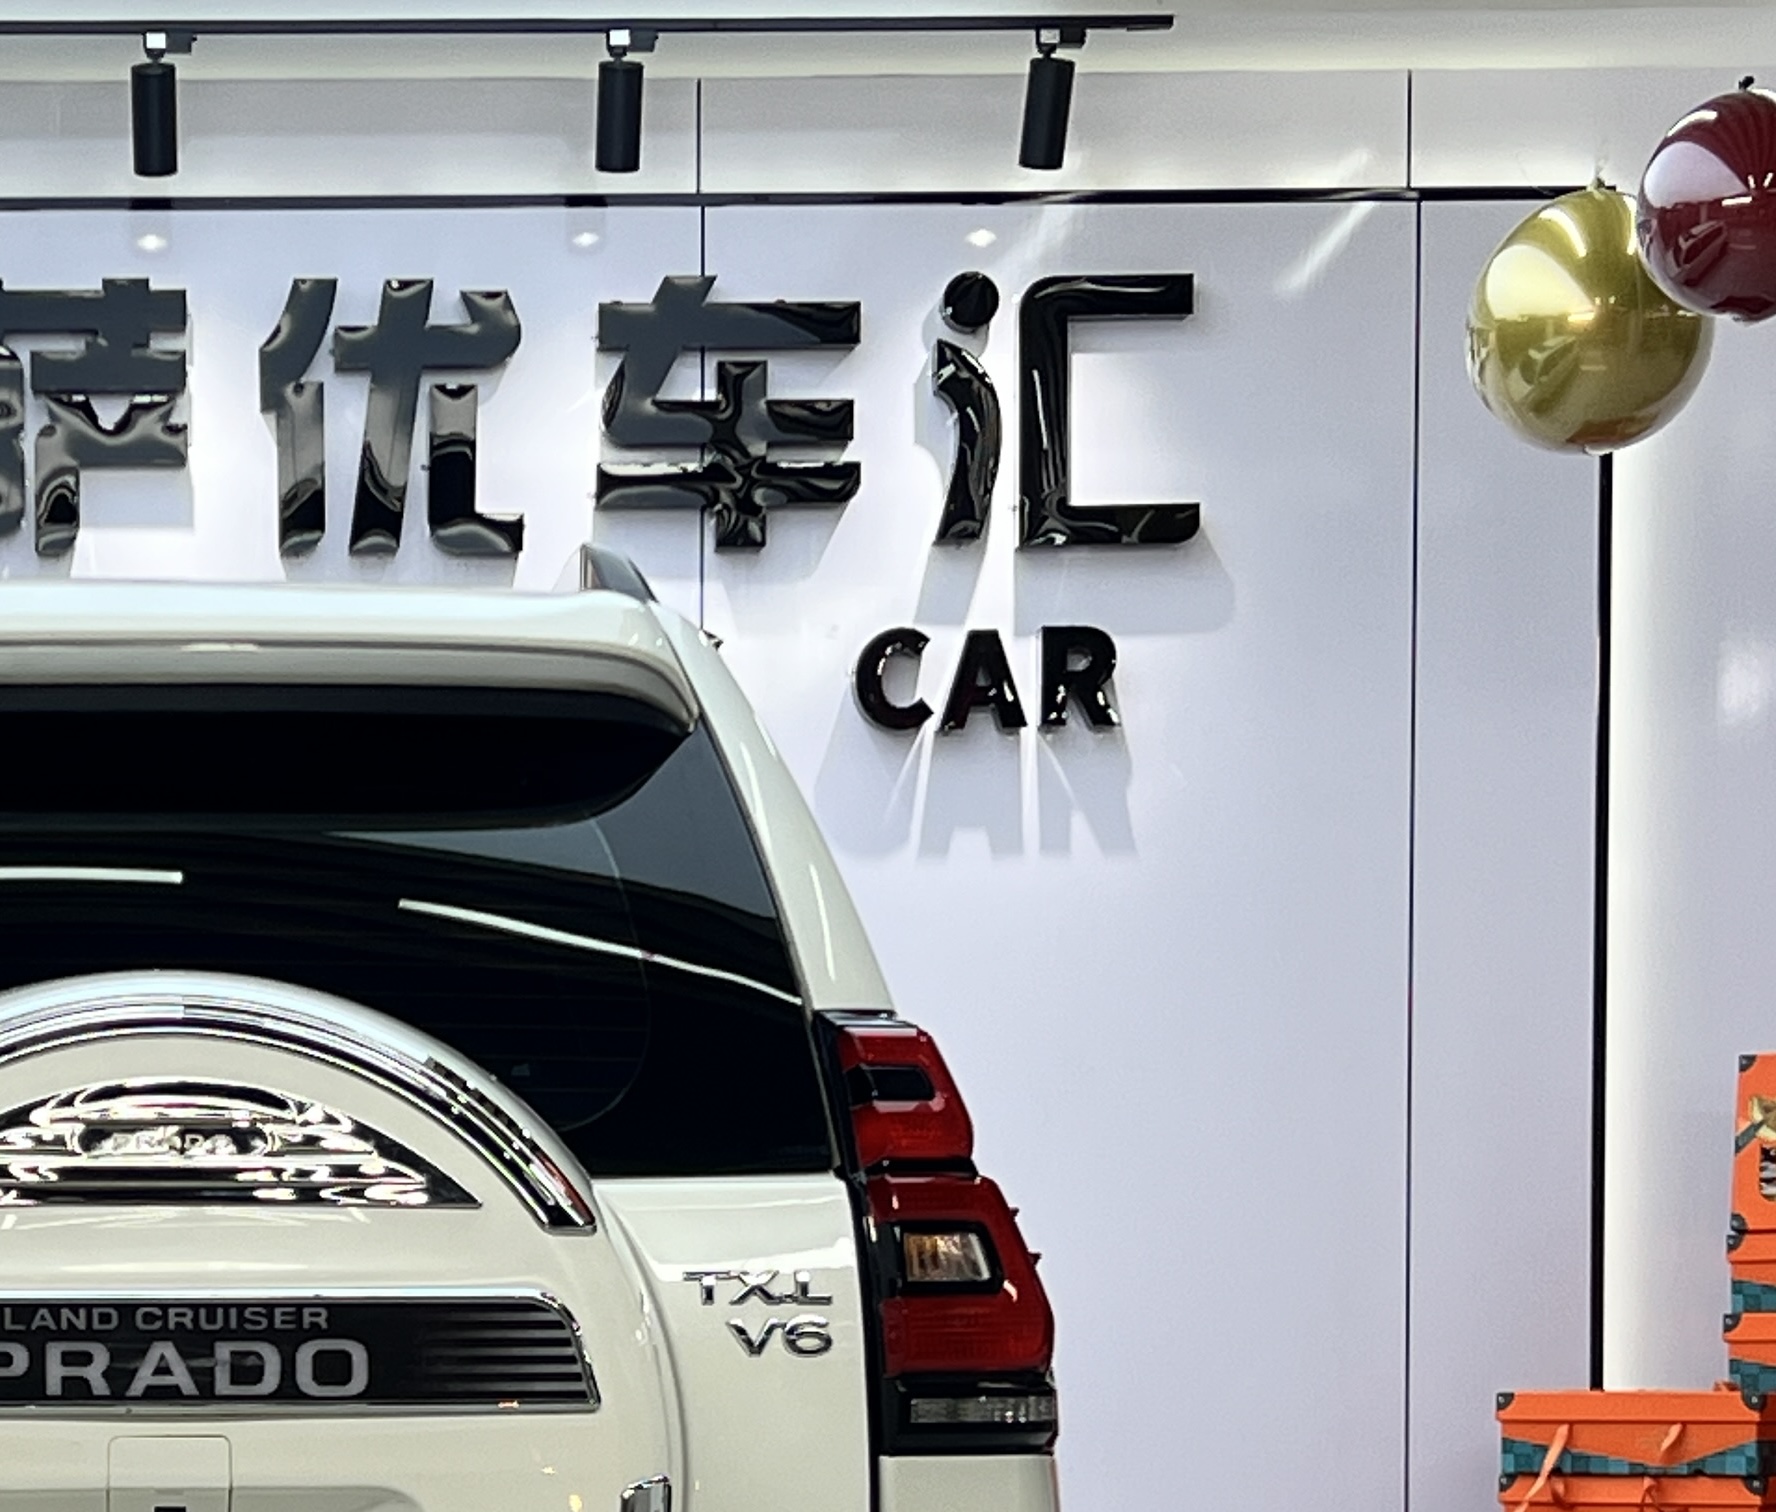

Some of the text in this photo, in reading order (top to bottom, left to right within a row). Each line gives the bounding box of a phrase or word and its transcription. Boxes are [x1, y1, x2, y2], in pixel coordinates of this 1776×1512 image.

[852, 626, 1121, 733] CAR
[683, 1270, 833, 1305] TXL
[3, 1306, 330, 1330] LAND CRUISER
[726, 1314, 833, 1358] V6
